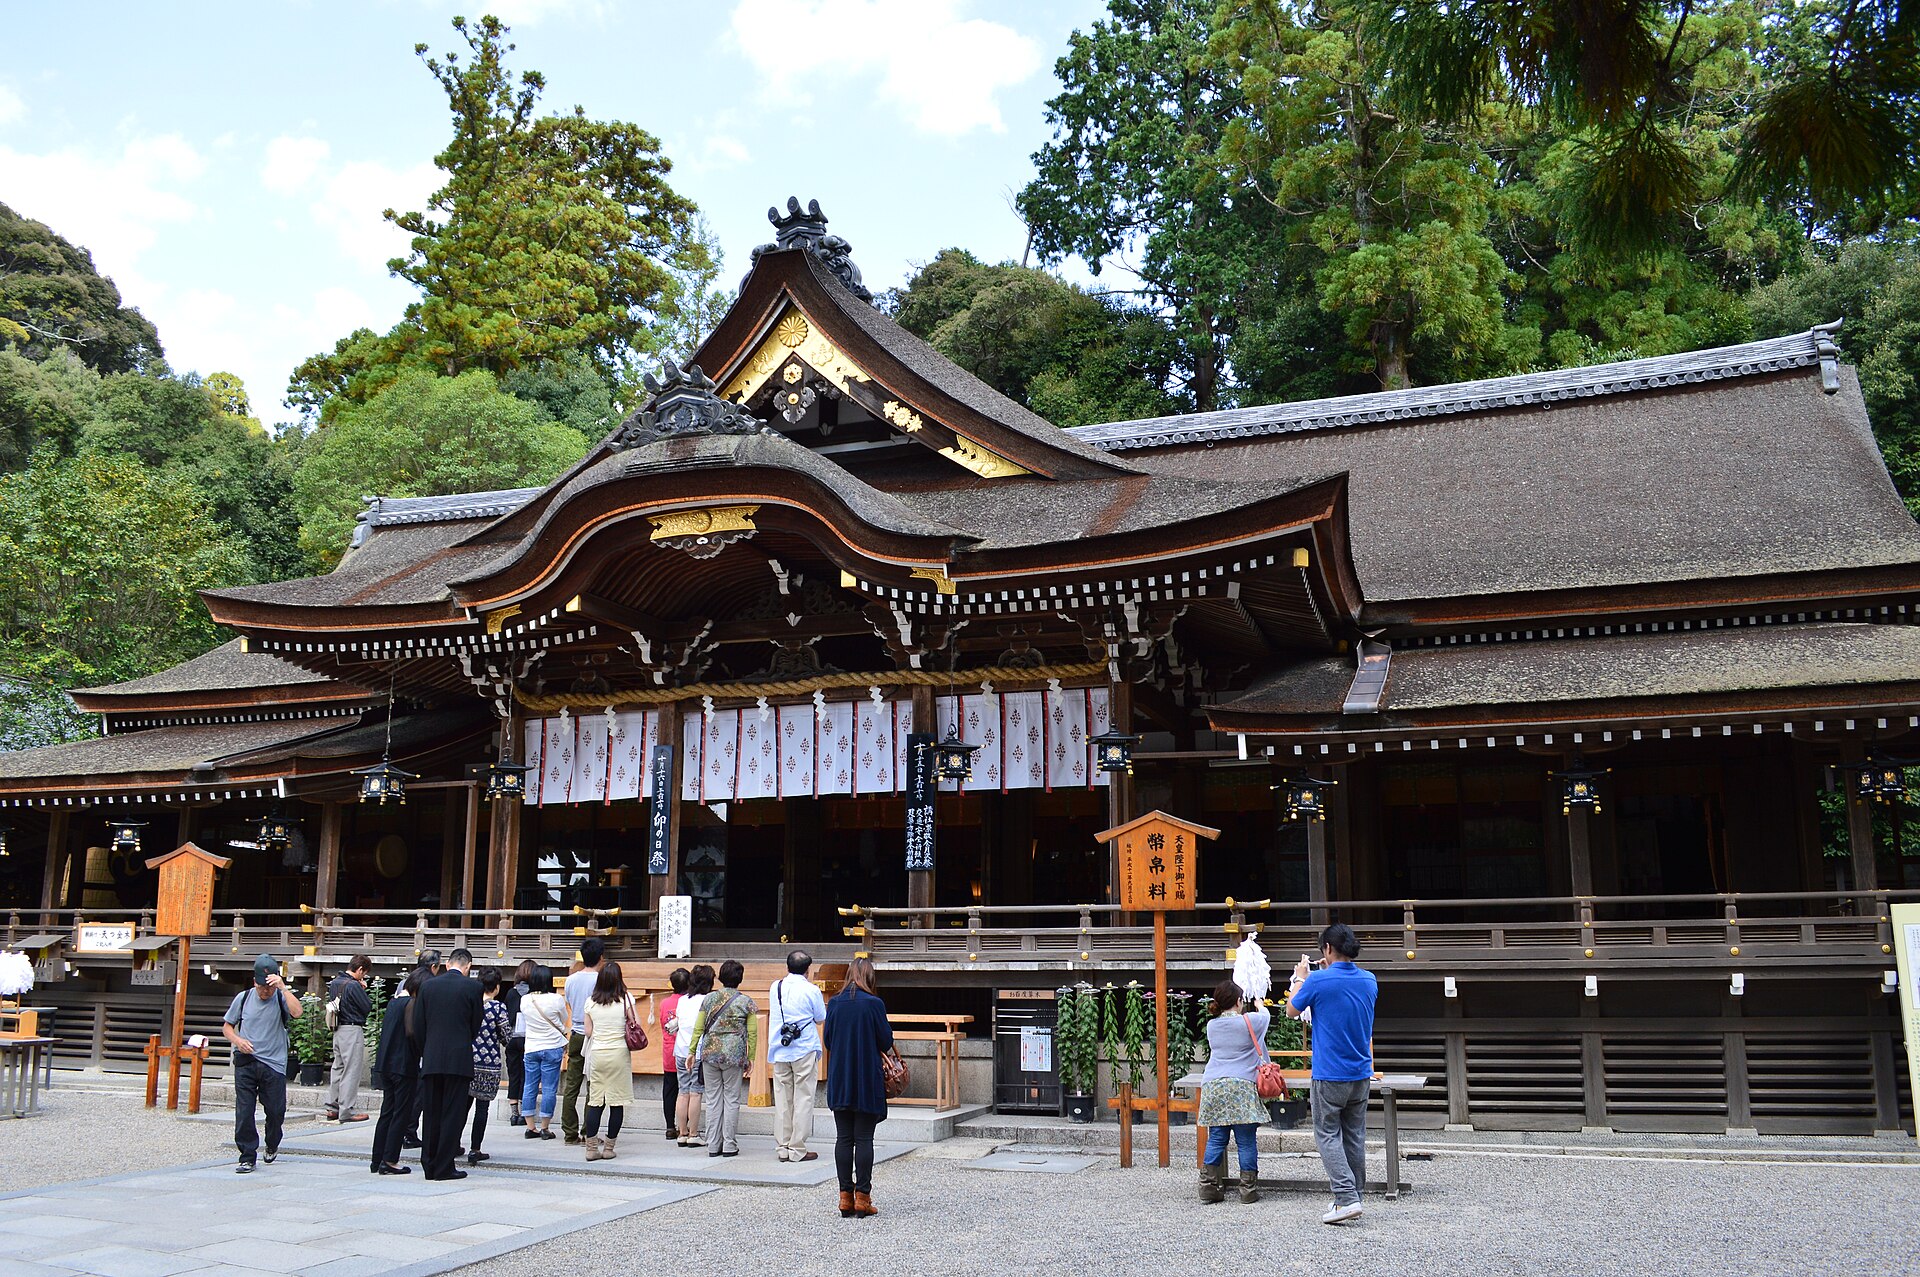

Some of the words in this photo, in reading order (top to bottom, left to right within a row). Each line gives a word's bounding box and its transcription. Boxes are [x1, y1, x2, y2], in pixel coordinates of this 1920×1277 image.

[650, 811, 667, 866] 卯の日祭
[1147, 832, 1167, 902] 幣帛料
[1174, 834, 1186, 900] 天皇陛下御下賜
